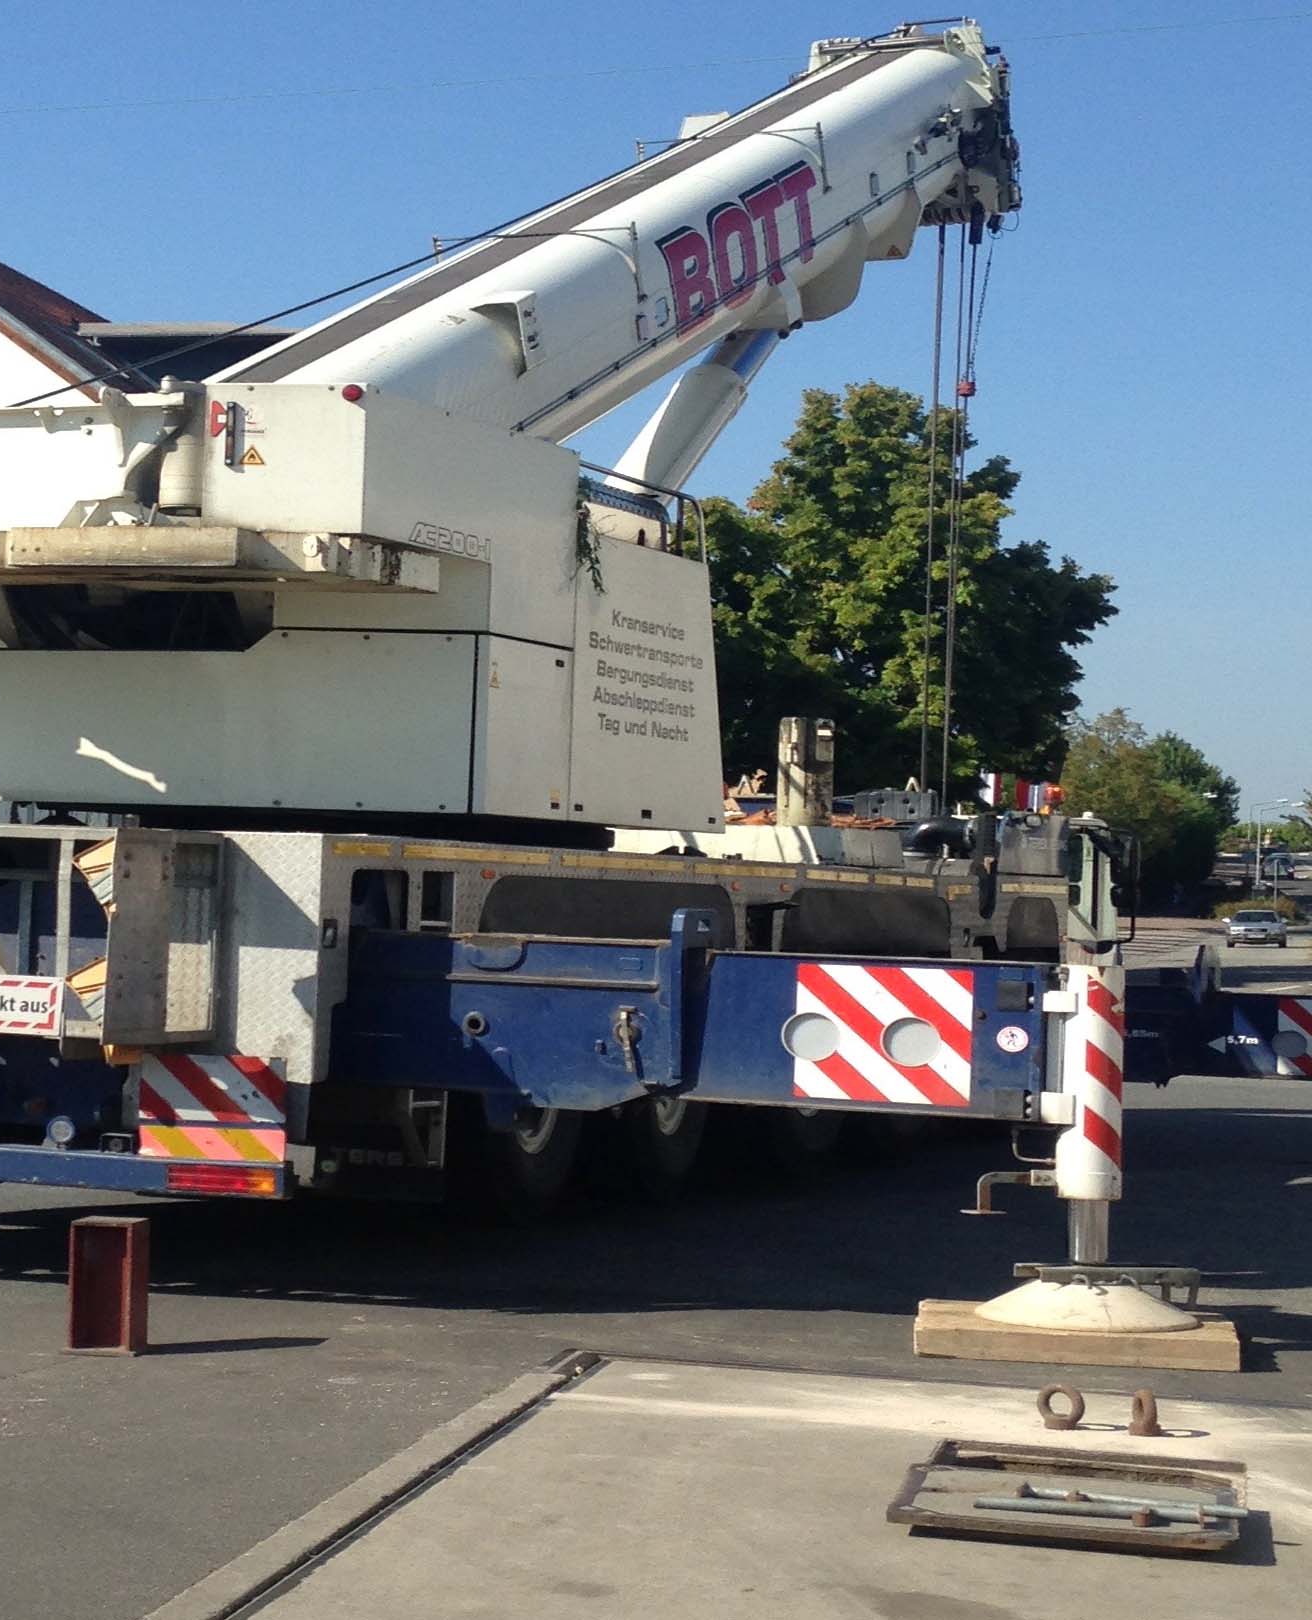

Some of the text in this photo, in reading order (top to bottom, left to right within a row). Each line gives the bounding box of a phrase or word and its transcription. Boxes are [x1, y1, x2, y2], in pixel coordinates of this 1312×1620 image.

[655, 160, 817, 339] BOTT
[611, 608, 686, 641] Kranservice
[588, 630, 704, 670] Schwertransporte
[596, 659, 694, 693] Bergungsdienst
[592, 686, 696, 718] Abschleppdienst
[598, 712, 689, 742] Tag und Nacht
[19, 999, 49, 1014] aus
